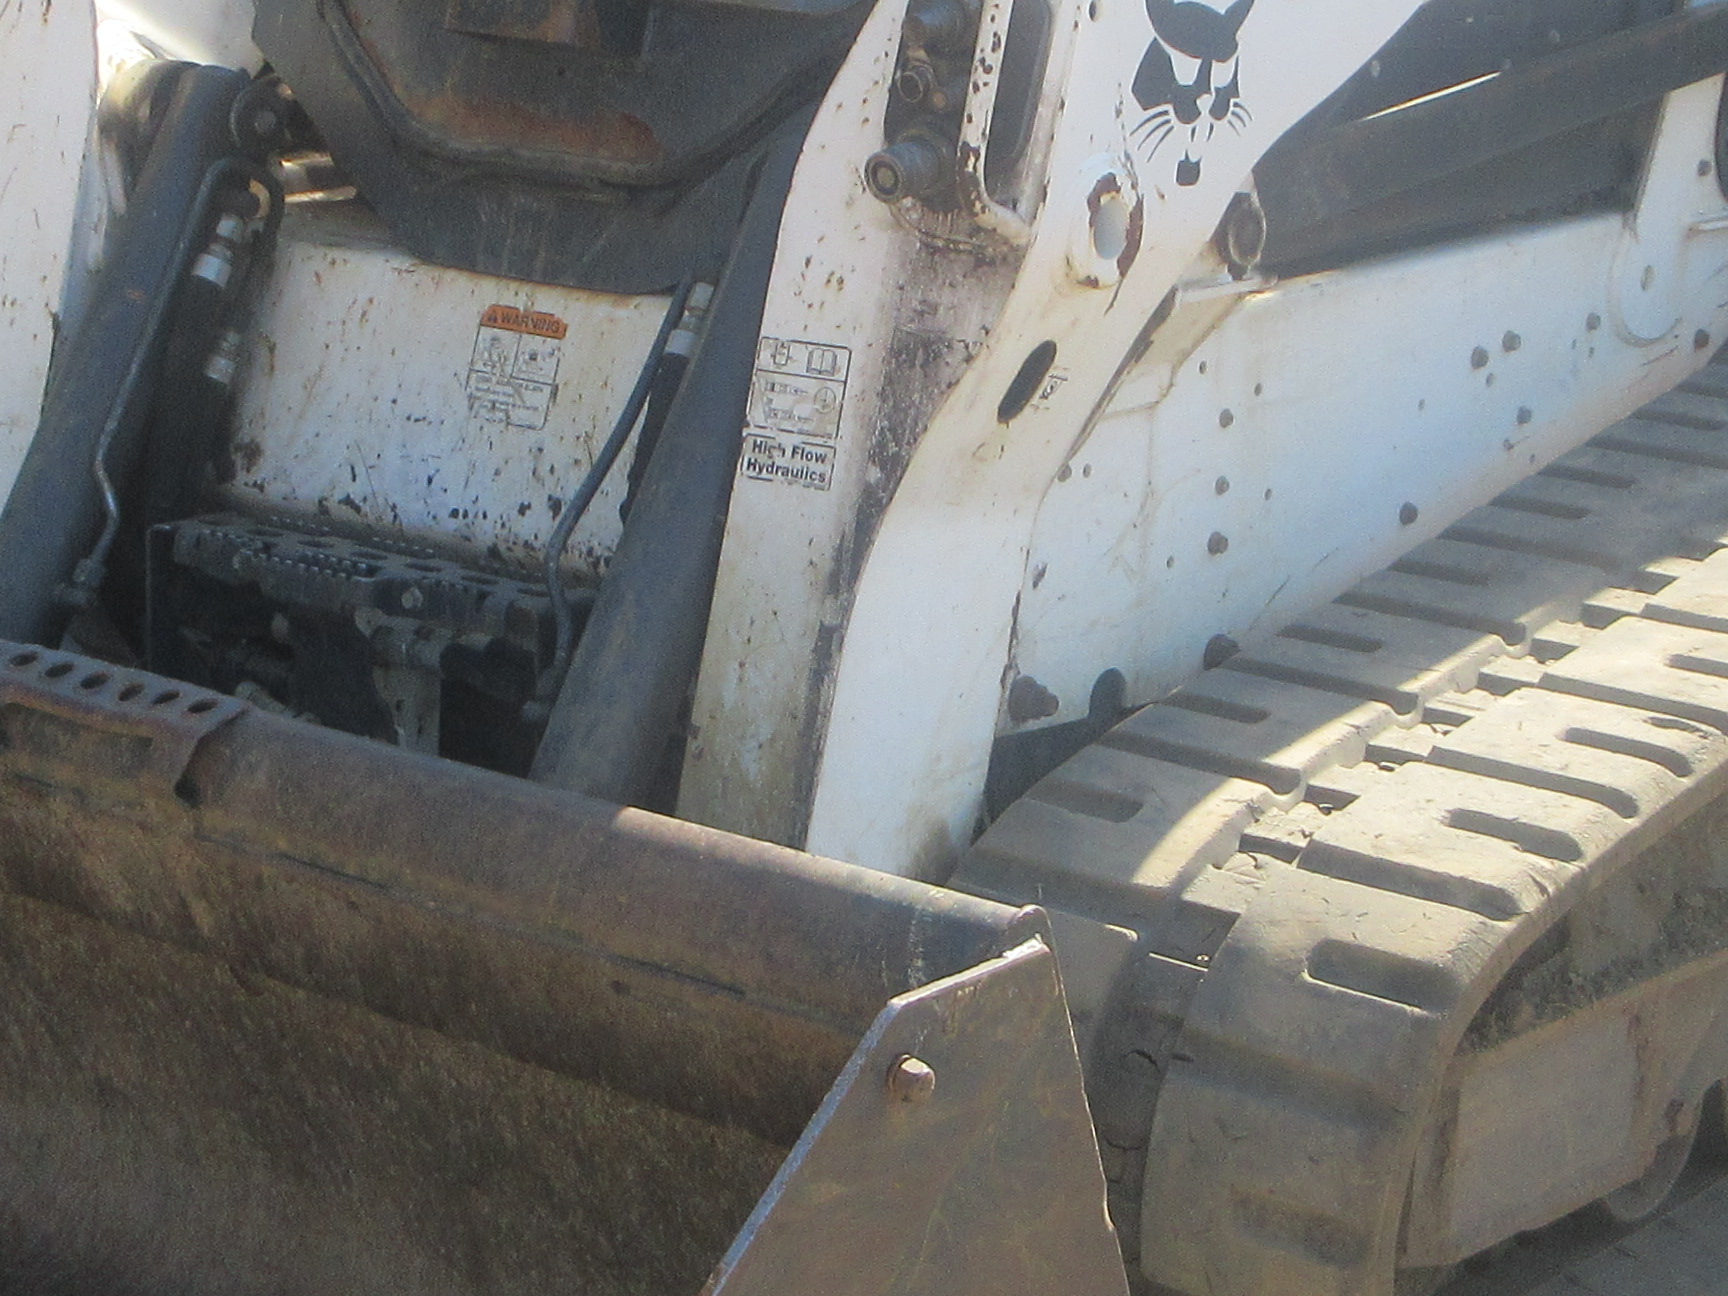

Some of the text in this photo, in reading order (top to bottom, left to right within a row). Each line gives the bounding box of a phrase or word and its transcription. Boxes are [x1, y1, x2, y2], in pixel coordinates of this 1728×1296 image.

[502, 311, 561, 334] WARNING
[752, 439, 828, 464] High Flow
[746, 457, 827, 484] Hydraulics
